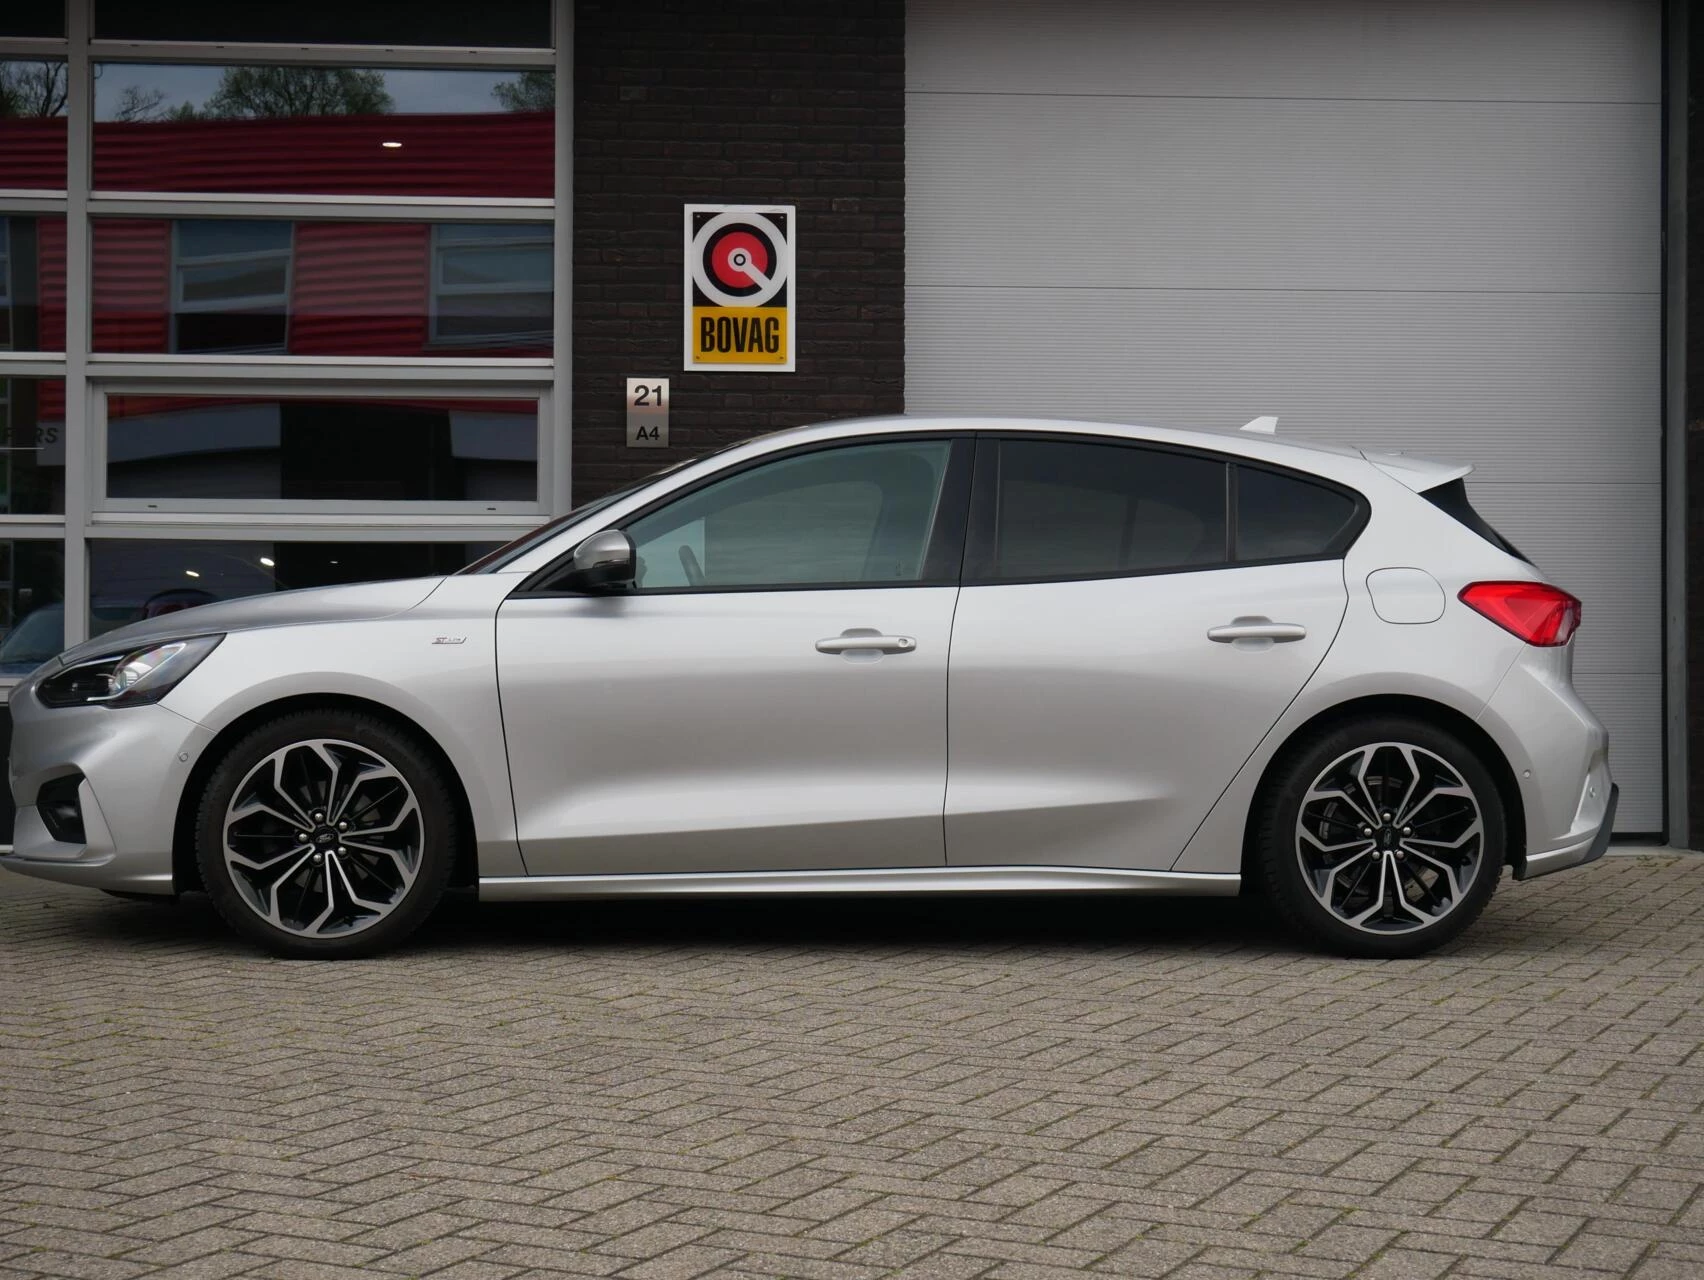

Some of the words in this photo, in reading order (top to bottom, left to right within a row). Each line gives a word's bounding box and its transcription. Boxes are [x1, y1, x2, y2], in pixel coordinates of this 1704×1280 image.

[701, 317, 779, 353] BOVAG
[634, 385, 662, 407] 21
[636, 426, 660, 441] A4
